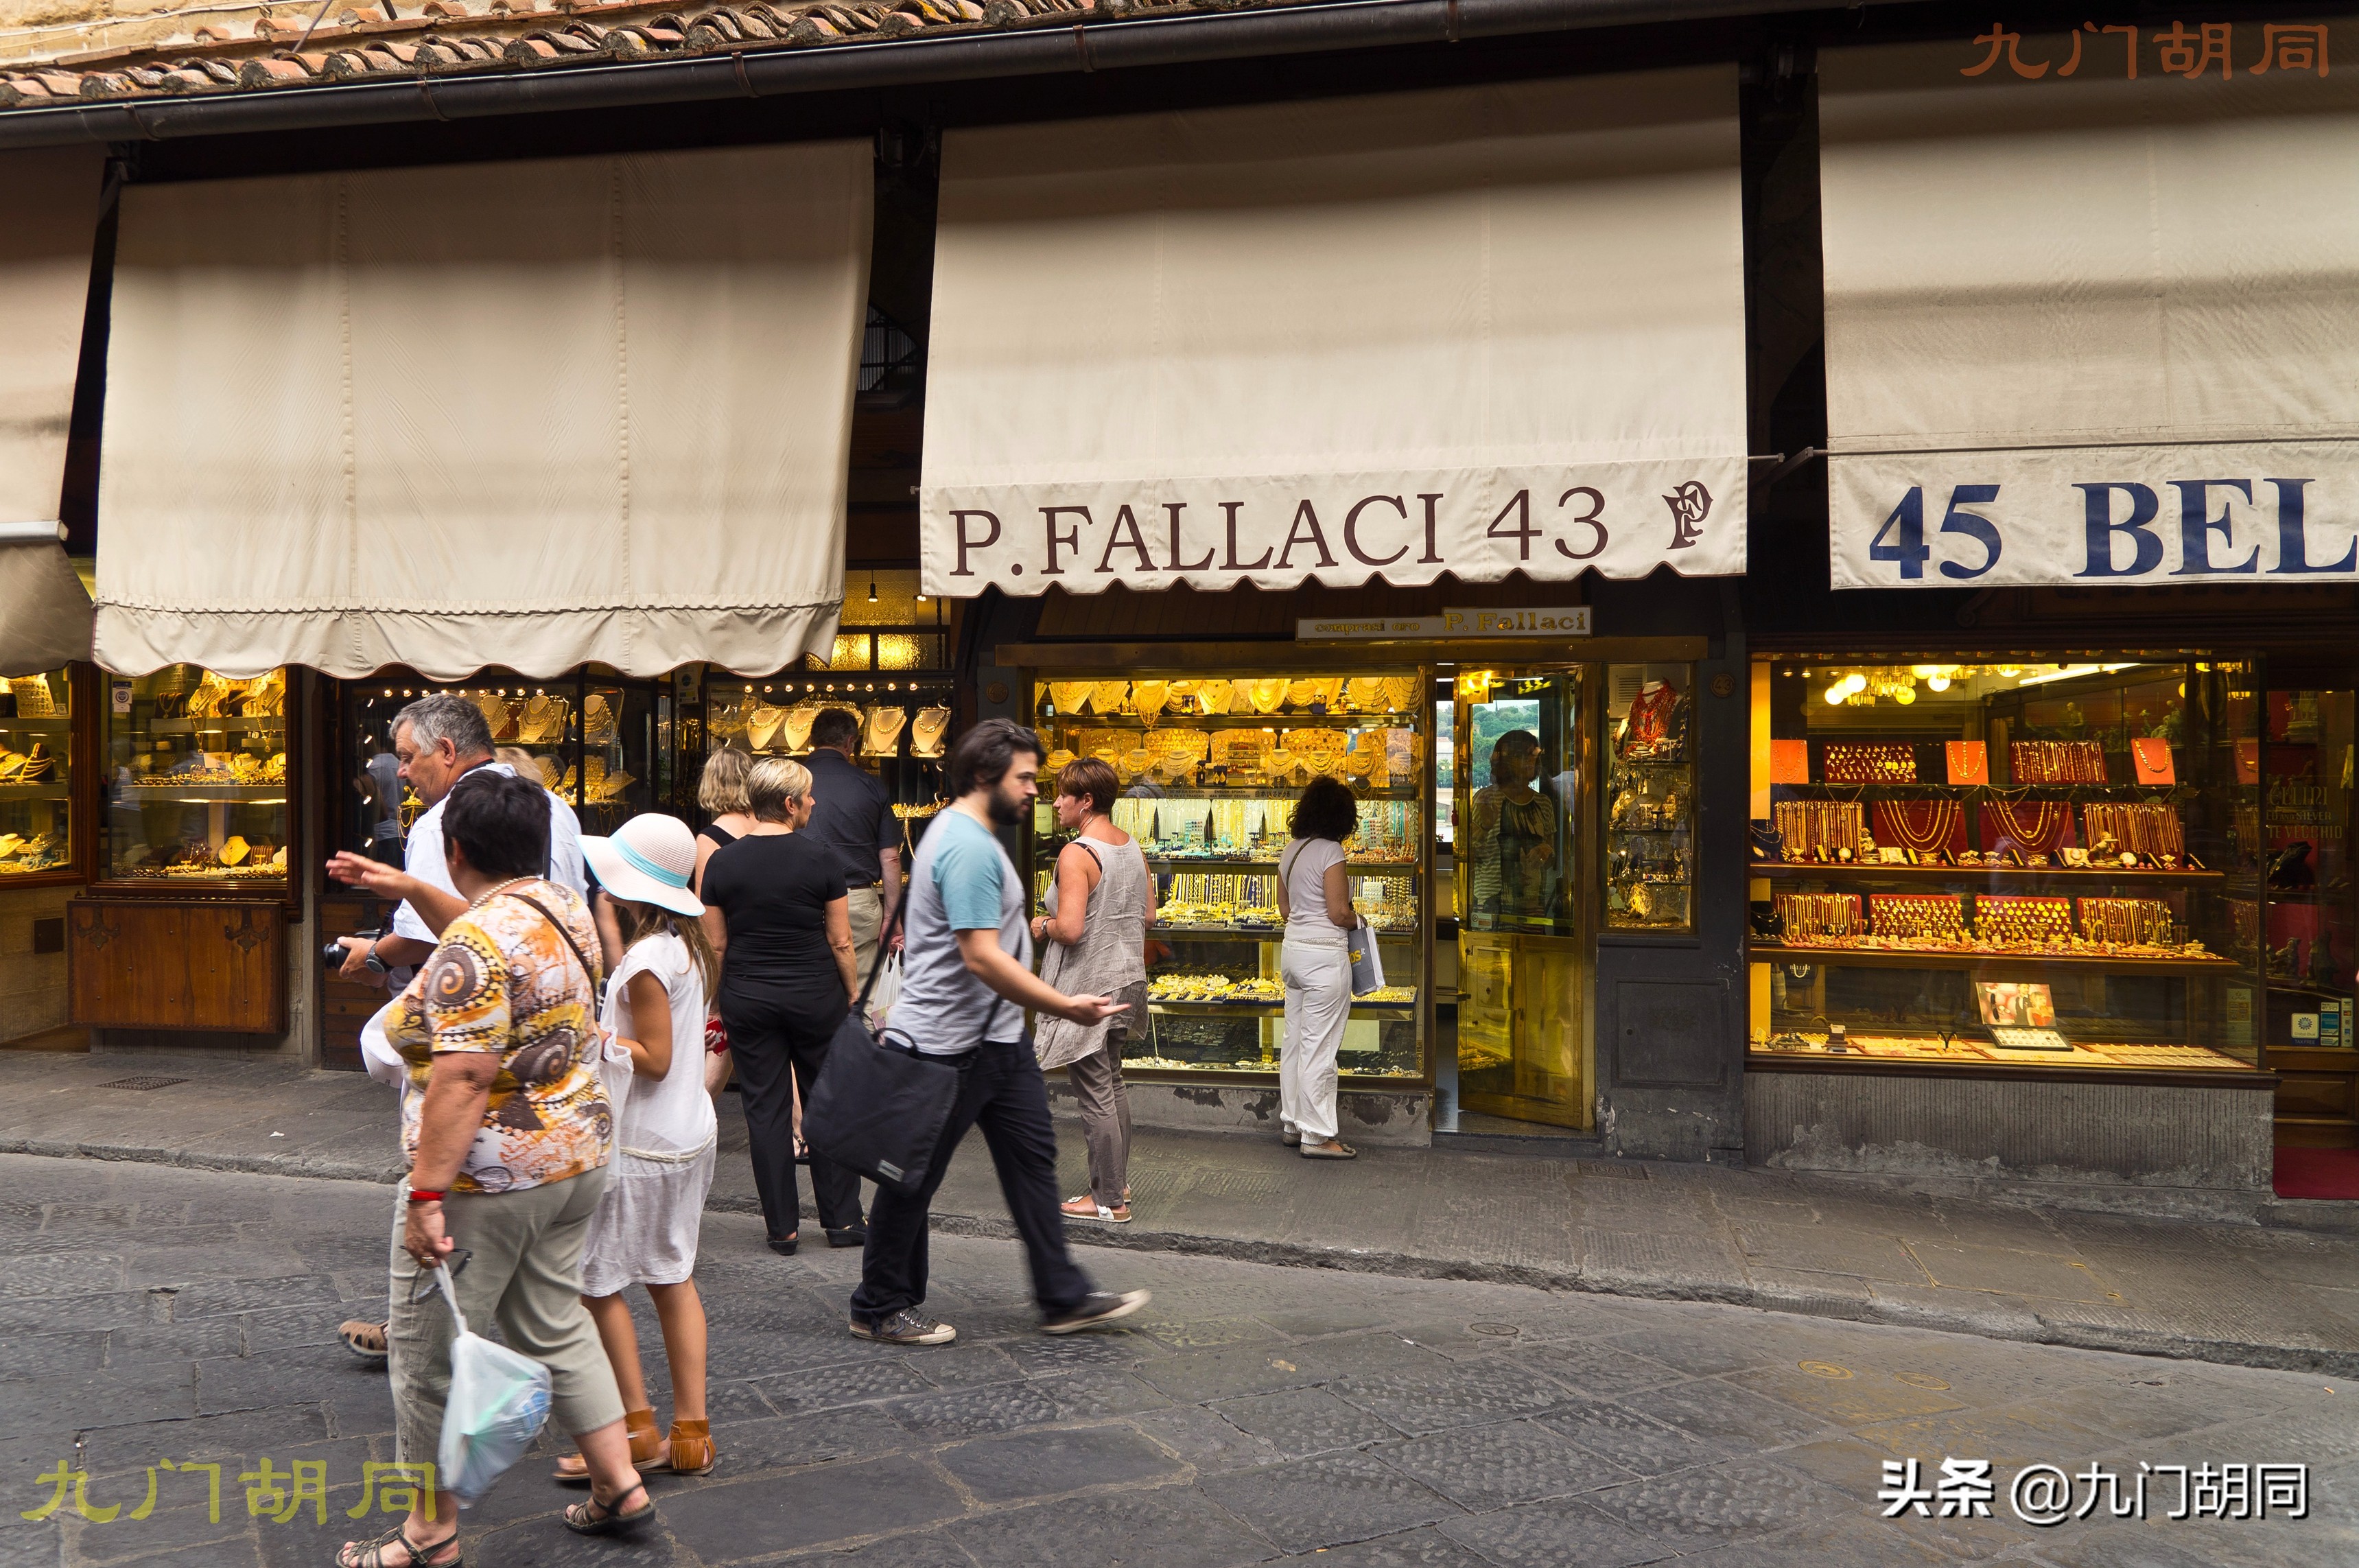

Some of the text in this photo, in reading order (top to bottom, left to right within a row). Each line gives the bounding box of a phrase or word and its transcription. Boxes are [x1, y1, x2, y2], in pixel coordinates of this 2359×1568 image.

[1487, 486, 1608, 561] 43
[1868, 478, 2358, 579] 45 BEL
[1315, 620, 1385, 635] comprasi
[1391, 622, 1420, 632] oro
[1476, 611, 1586, 631] Fallaci
[2268, 786, 2328, 806] ELLINI
[2296, 811, 2332, 821] SILVER
[2285, 825, 2343, 839] VECCHIO
